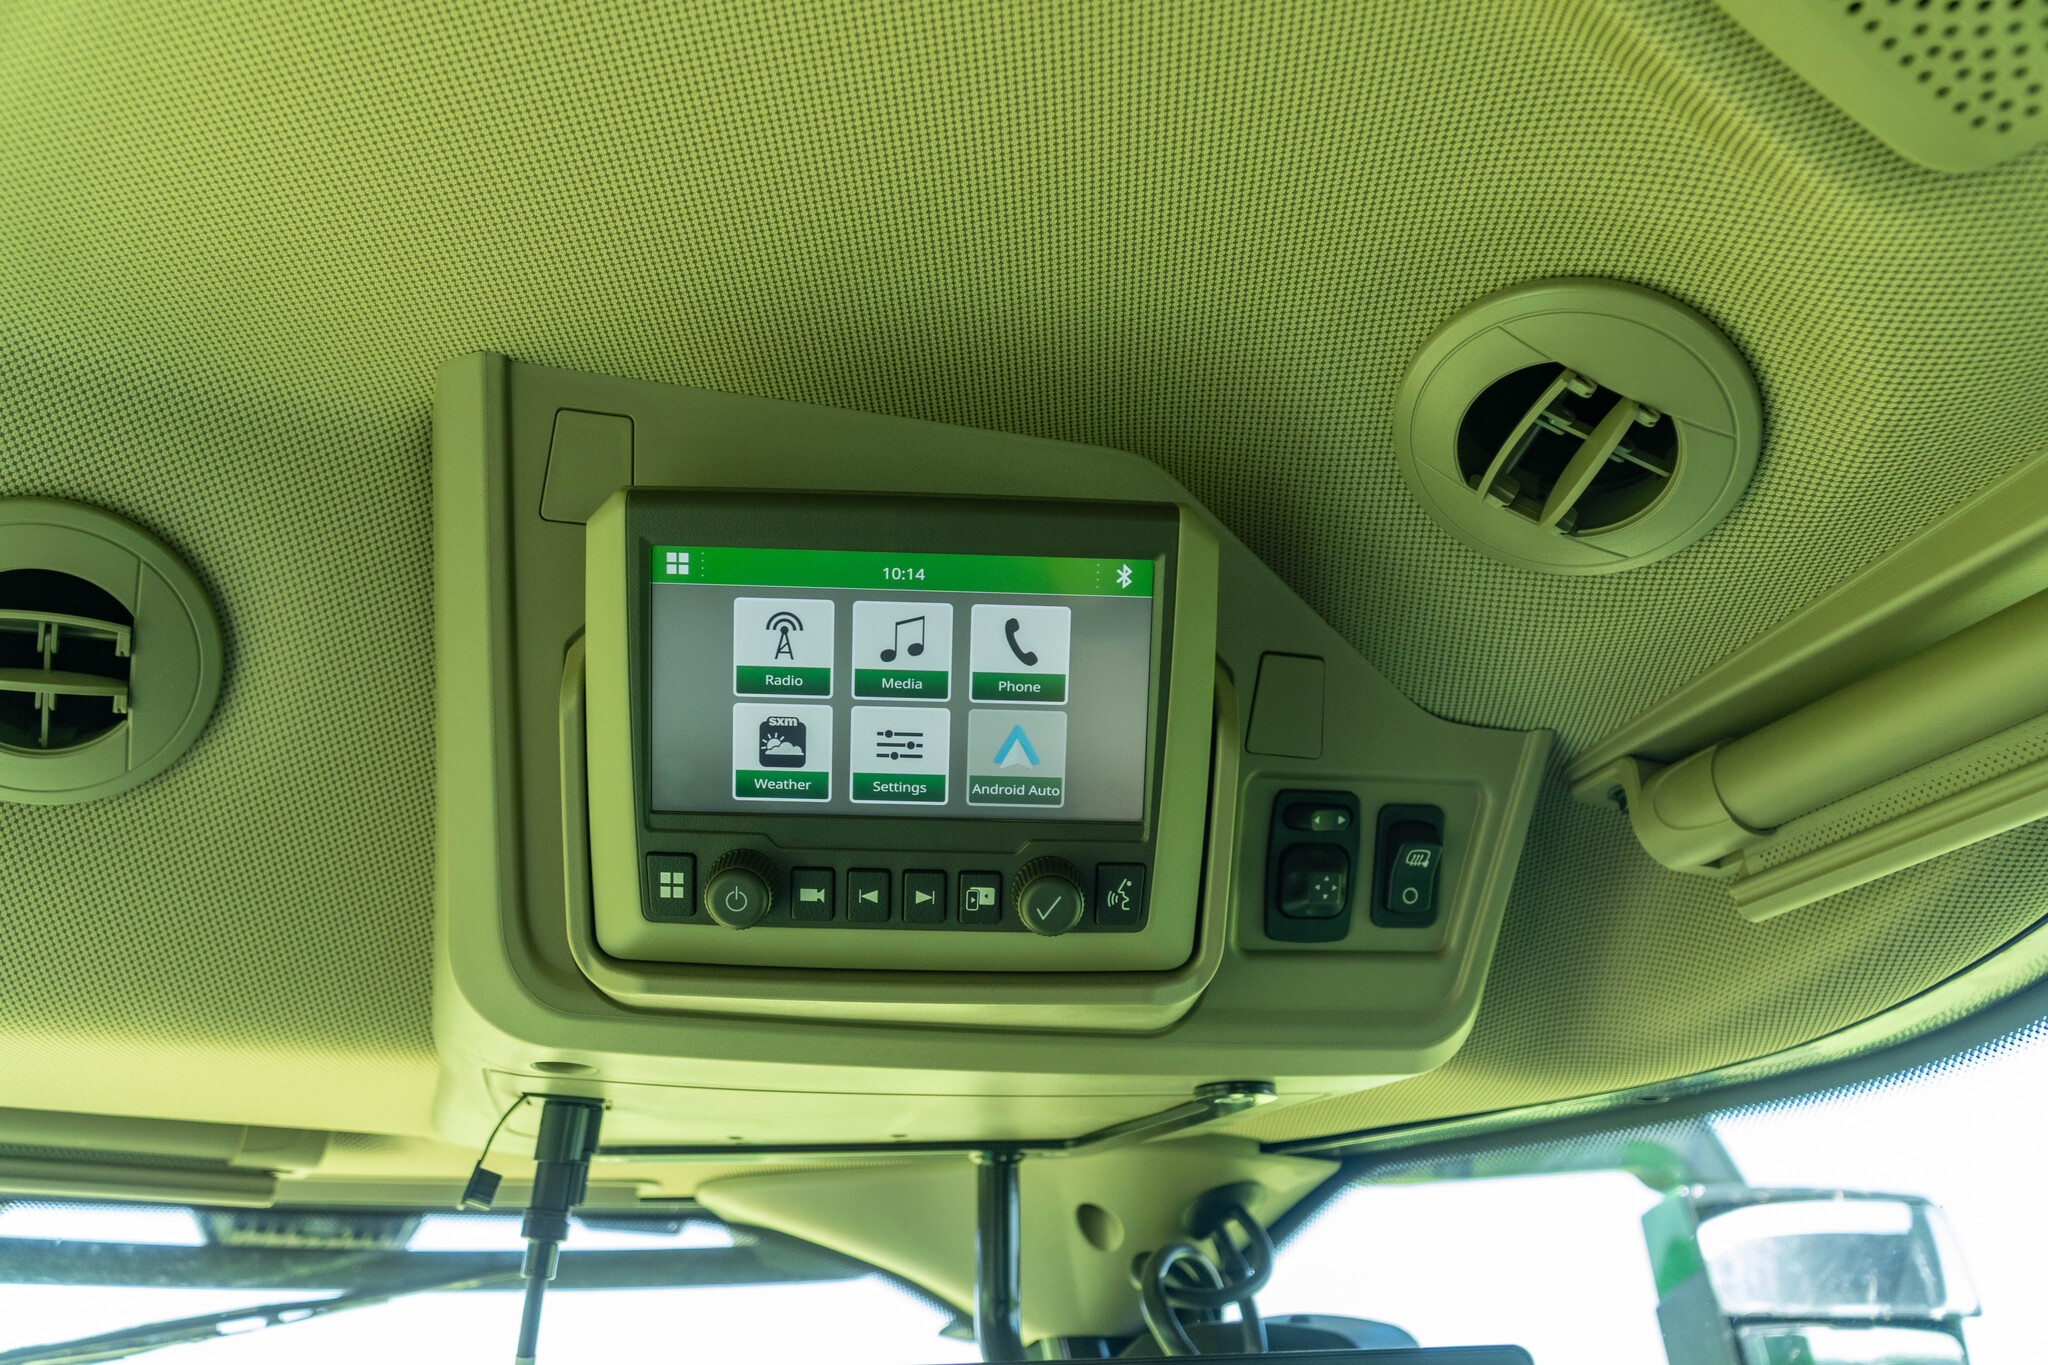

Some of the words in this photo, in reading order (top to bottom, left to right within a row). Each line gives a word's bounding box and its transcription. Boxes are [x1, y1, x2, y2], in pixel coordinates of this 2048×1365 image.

[882, 567, 926, 582] 10:14
[765, 673, 804, 688] Radio
[881, 676, 923, 691] Media
[998, 679, 1041, 694] Phone
[768, 716, 798, 727] sxm
[754, 777, 812, 792] Weather
[872, 780, 927, 796] Settings
[972, 782, 1024, 797] Android
[1028, 785, 1061, 798] Auto
